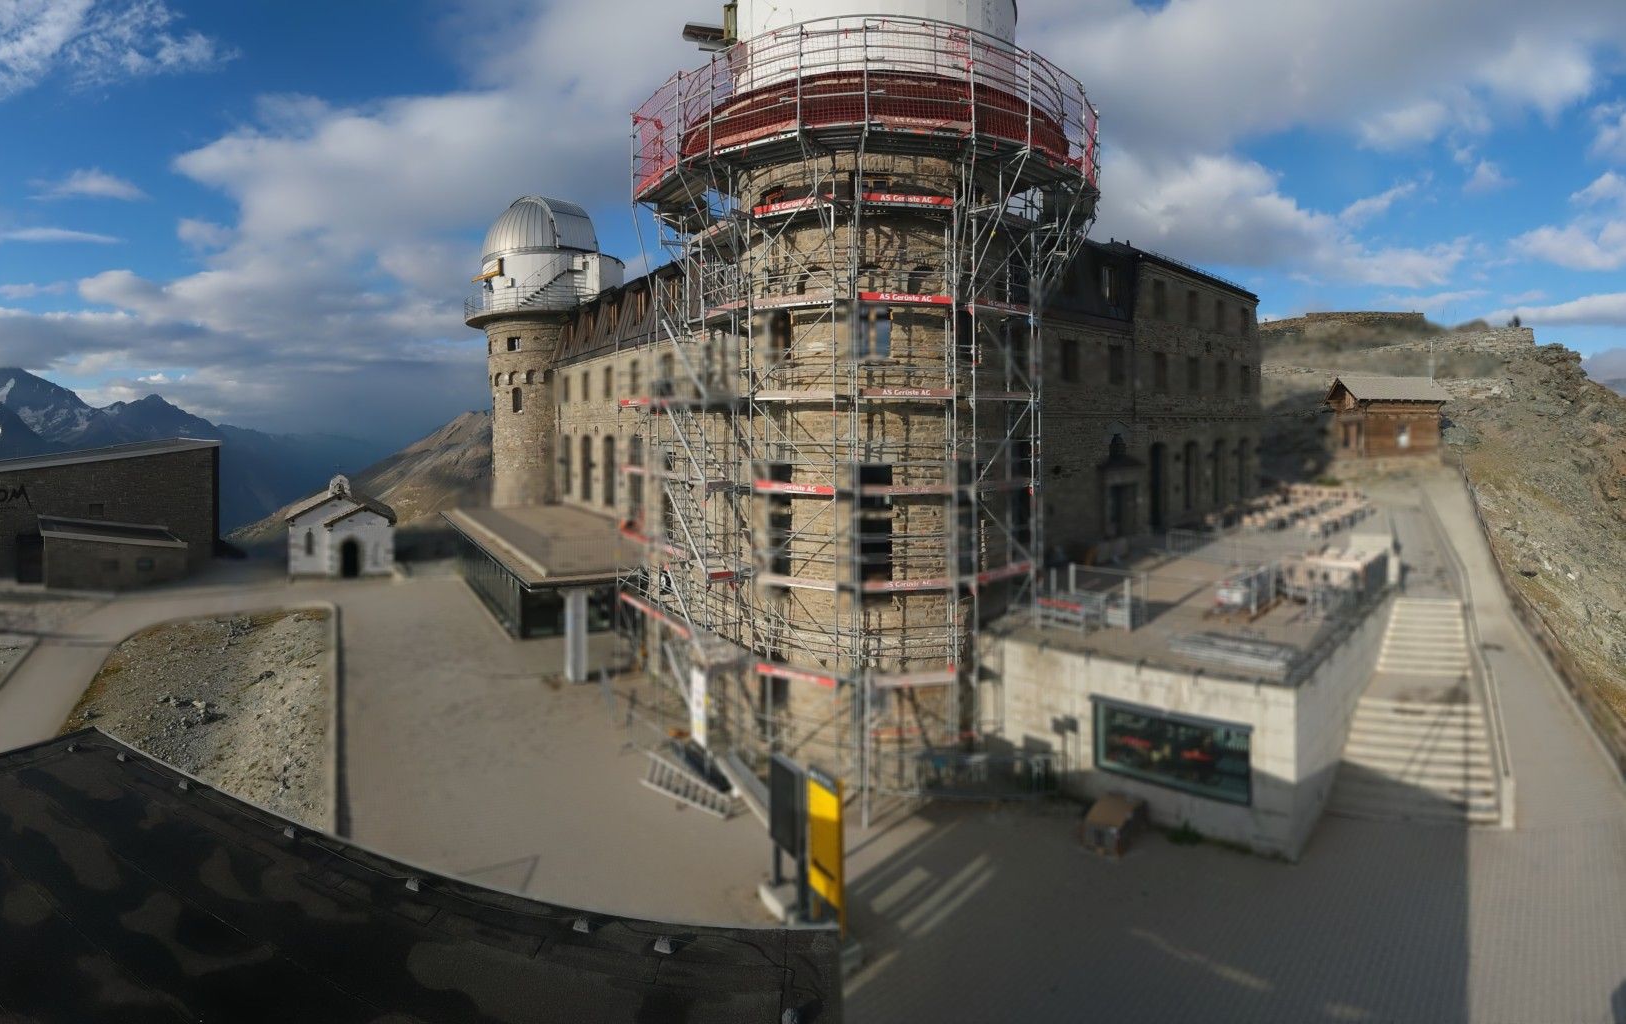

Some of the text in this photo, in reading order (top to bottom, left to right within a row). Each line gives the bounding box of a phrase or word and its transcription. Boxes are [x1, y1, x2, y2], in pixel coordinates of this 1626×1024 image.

[880, 194, 891, 202] AS
[921, 196, 933, 204] AG
[771, 203, 780, 211] AS
[892, 294, 920, 302] Gerüste
[921, 295, 932, 303] AG
[806, 485, 817, 493] AG
